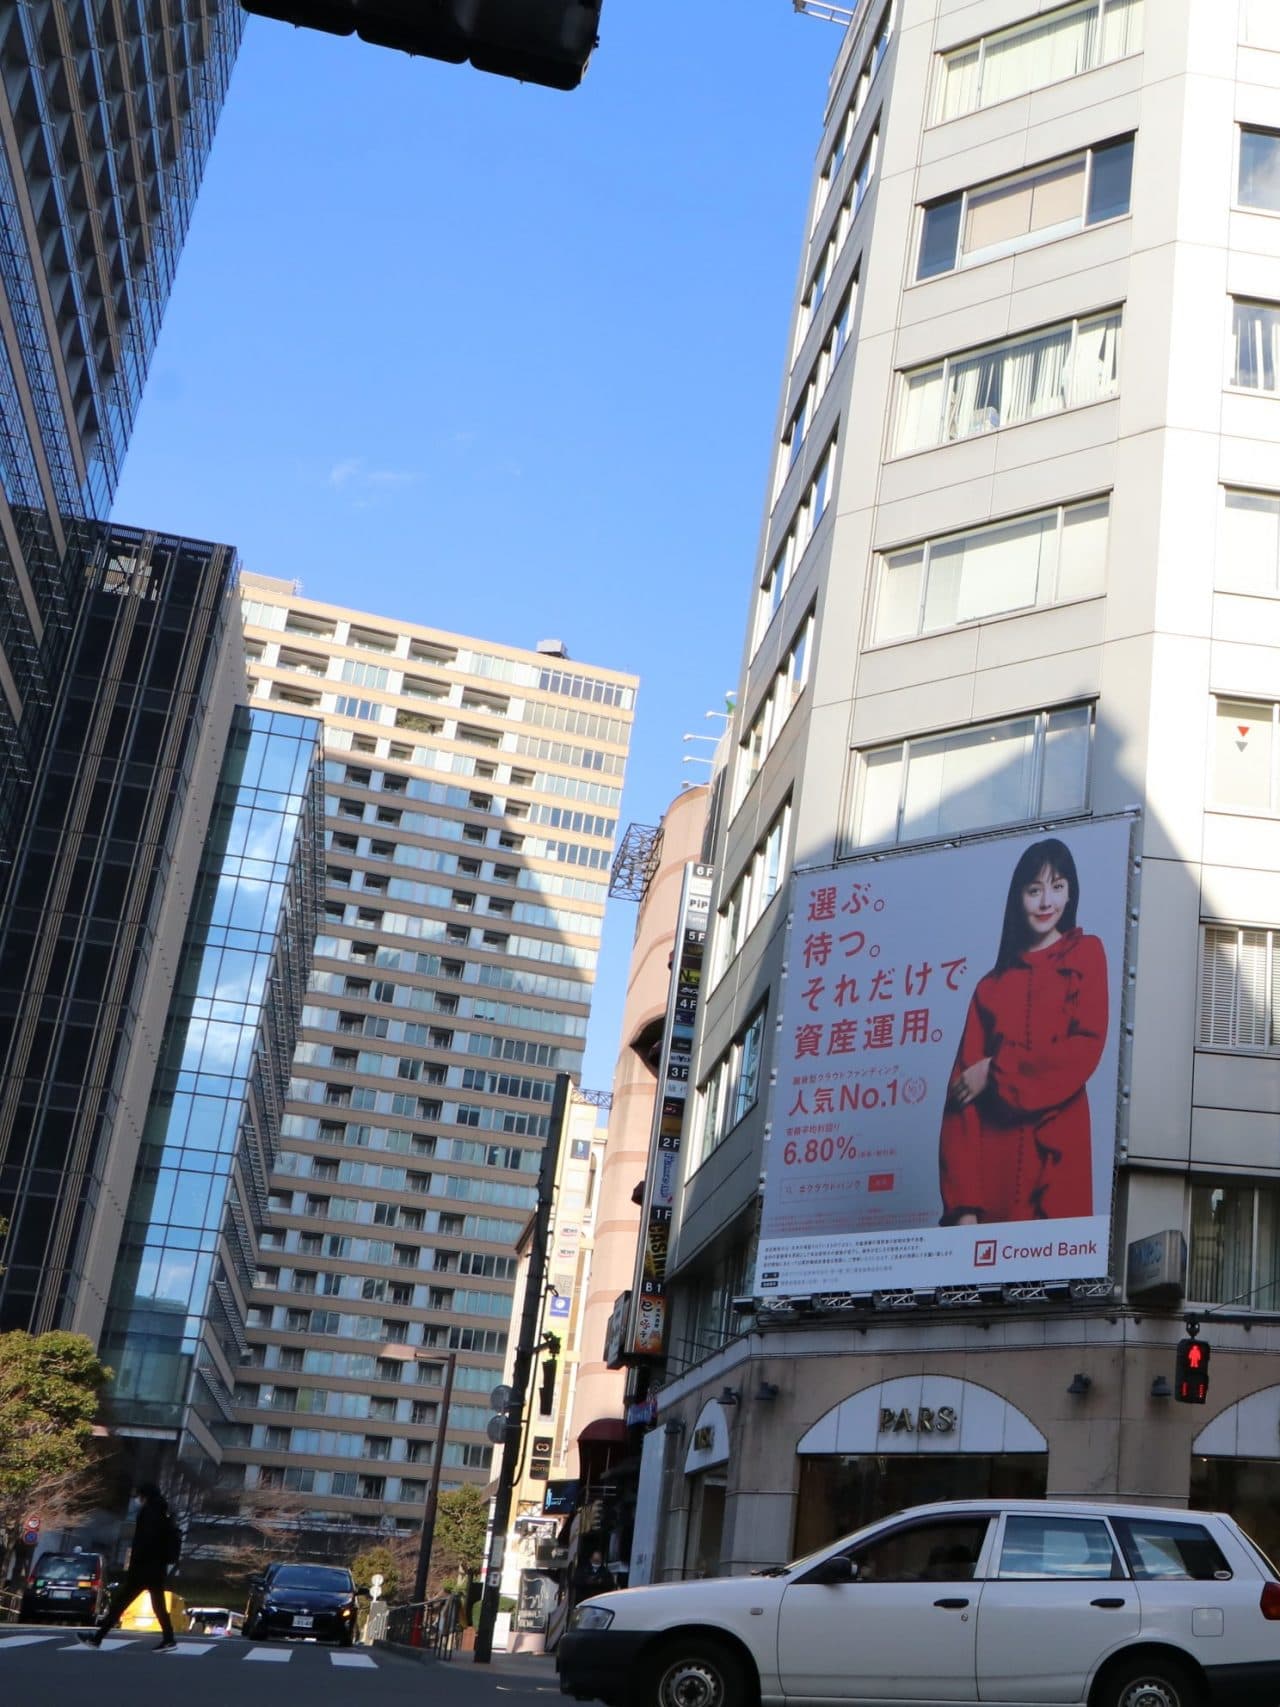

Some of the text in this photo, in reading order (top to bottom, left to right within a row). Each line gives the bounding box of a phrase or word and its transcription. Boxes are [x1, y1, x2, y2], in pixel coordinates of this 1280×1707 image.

[806, 882, 886, 924] 選ぶ。
[802, 928, 881, 969] 待つ。
[800, 956, 969, 1013] それだけで
[793, 1007, 943, 1061] 資産運用。
[671, 1067, 689, 1078] 3F
[663, 1137, 681, 1148] 2F
[783, 1135, 857, 1167] 6.80%
[1002, 1241, 1098, 1262] Crowd Bank
[878, 1405, 957, 1433] PARS
